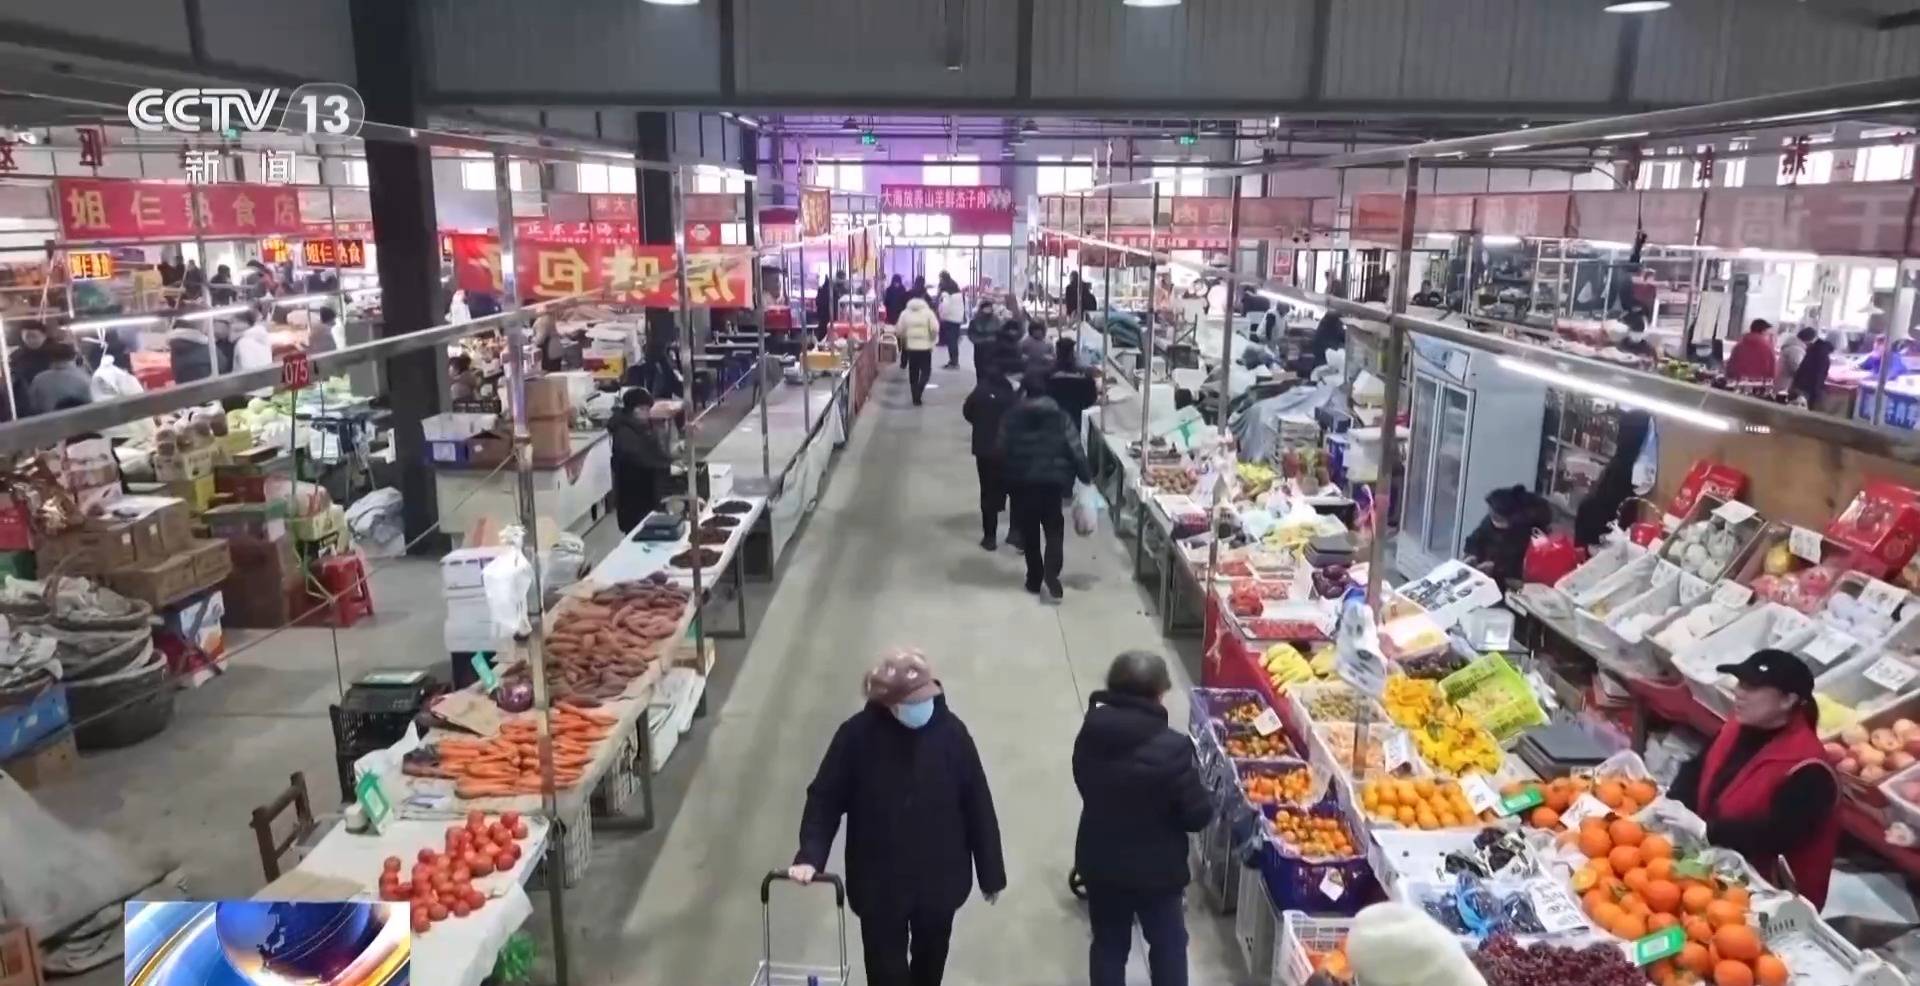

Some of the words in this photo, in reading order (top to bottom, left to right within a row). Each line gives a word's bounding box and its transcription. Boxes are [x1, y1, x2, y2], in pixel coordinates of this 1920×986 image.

[67, 188, 296, 230] 姐仨熟食店
[284, 359, 309, 385] 075
